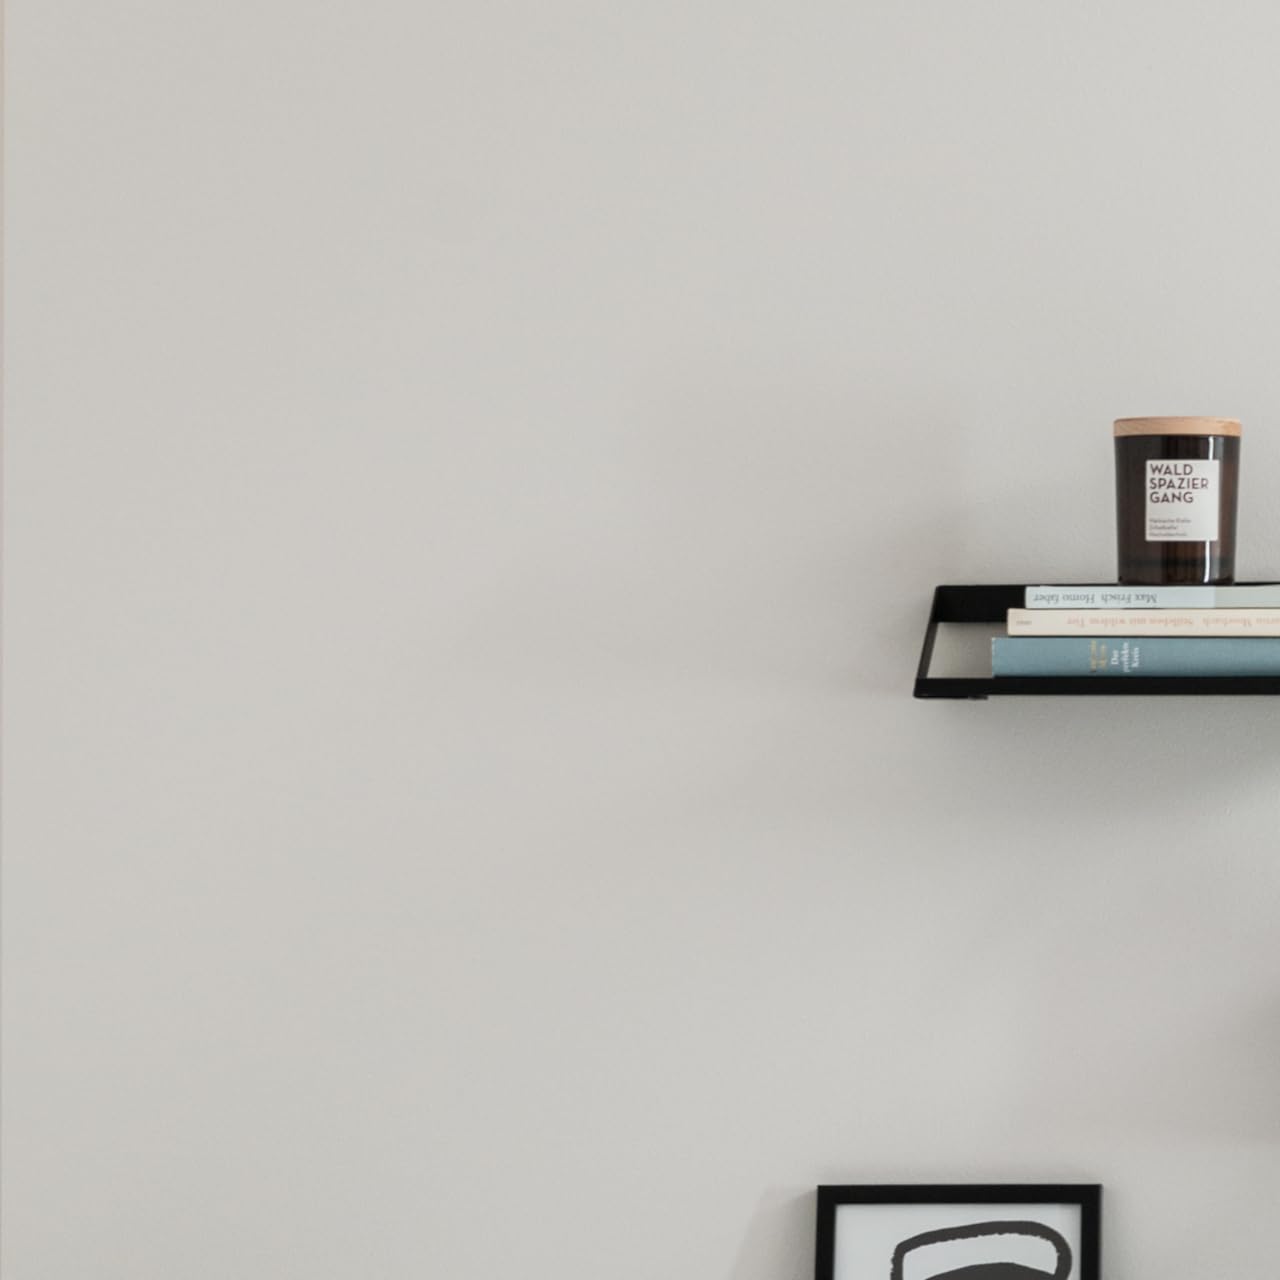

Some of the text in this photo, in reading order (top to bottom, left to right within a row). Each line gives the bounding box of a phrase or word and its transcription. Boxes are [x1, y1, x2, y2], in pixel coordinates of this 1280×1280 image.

[1150, 463, 1193, 476] WALD
[1149, 477, 1209, 490] SPAZIER
[1149, 491, 1194, 504] GANG
[1033, 593, 1158, 604] Max Frisch Homo faber
